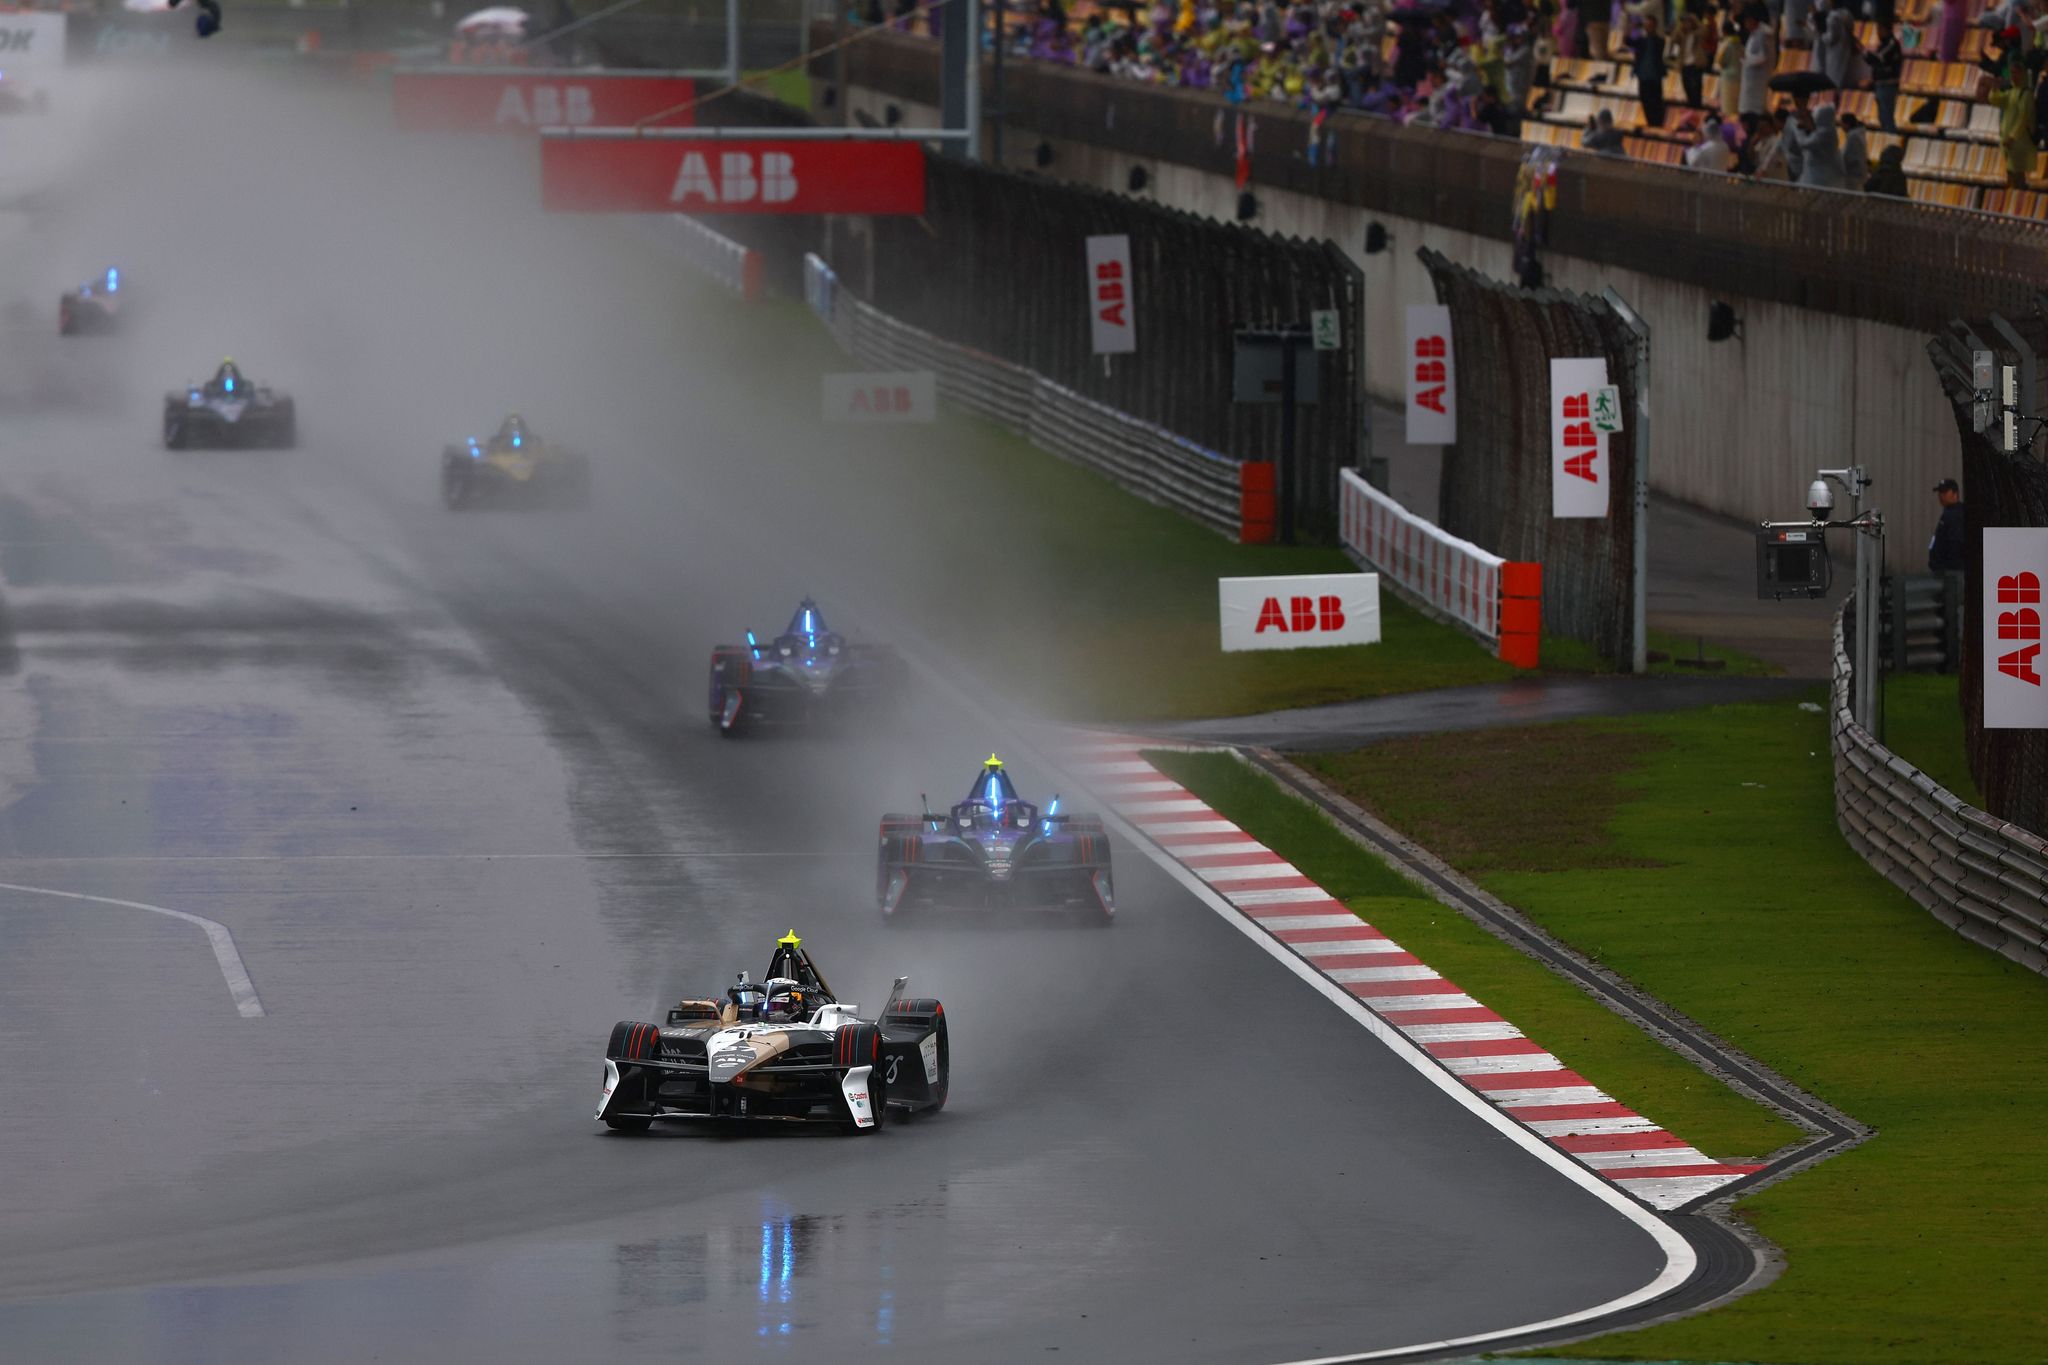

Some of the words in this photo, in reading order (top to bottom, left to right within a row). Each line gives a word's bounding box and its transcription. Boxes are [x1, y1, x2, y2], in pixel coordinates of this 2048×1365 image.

[496, 85, 595, 124] ABB
[671, 152, 797, 203] ABB
[1096, 259, 1126, 328] ABB
[847, 386, 913, 414] ABB
[1415, 335, 1447, 415] ABB
[1562, 391, 1599, 485] ABB
[1255, 595, 1345, 634] ABB
[1996, 571, 2042, 687] ABB
[790, 985, 806, 993] Google
[806, 986, 819, 994] Cloud
